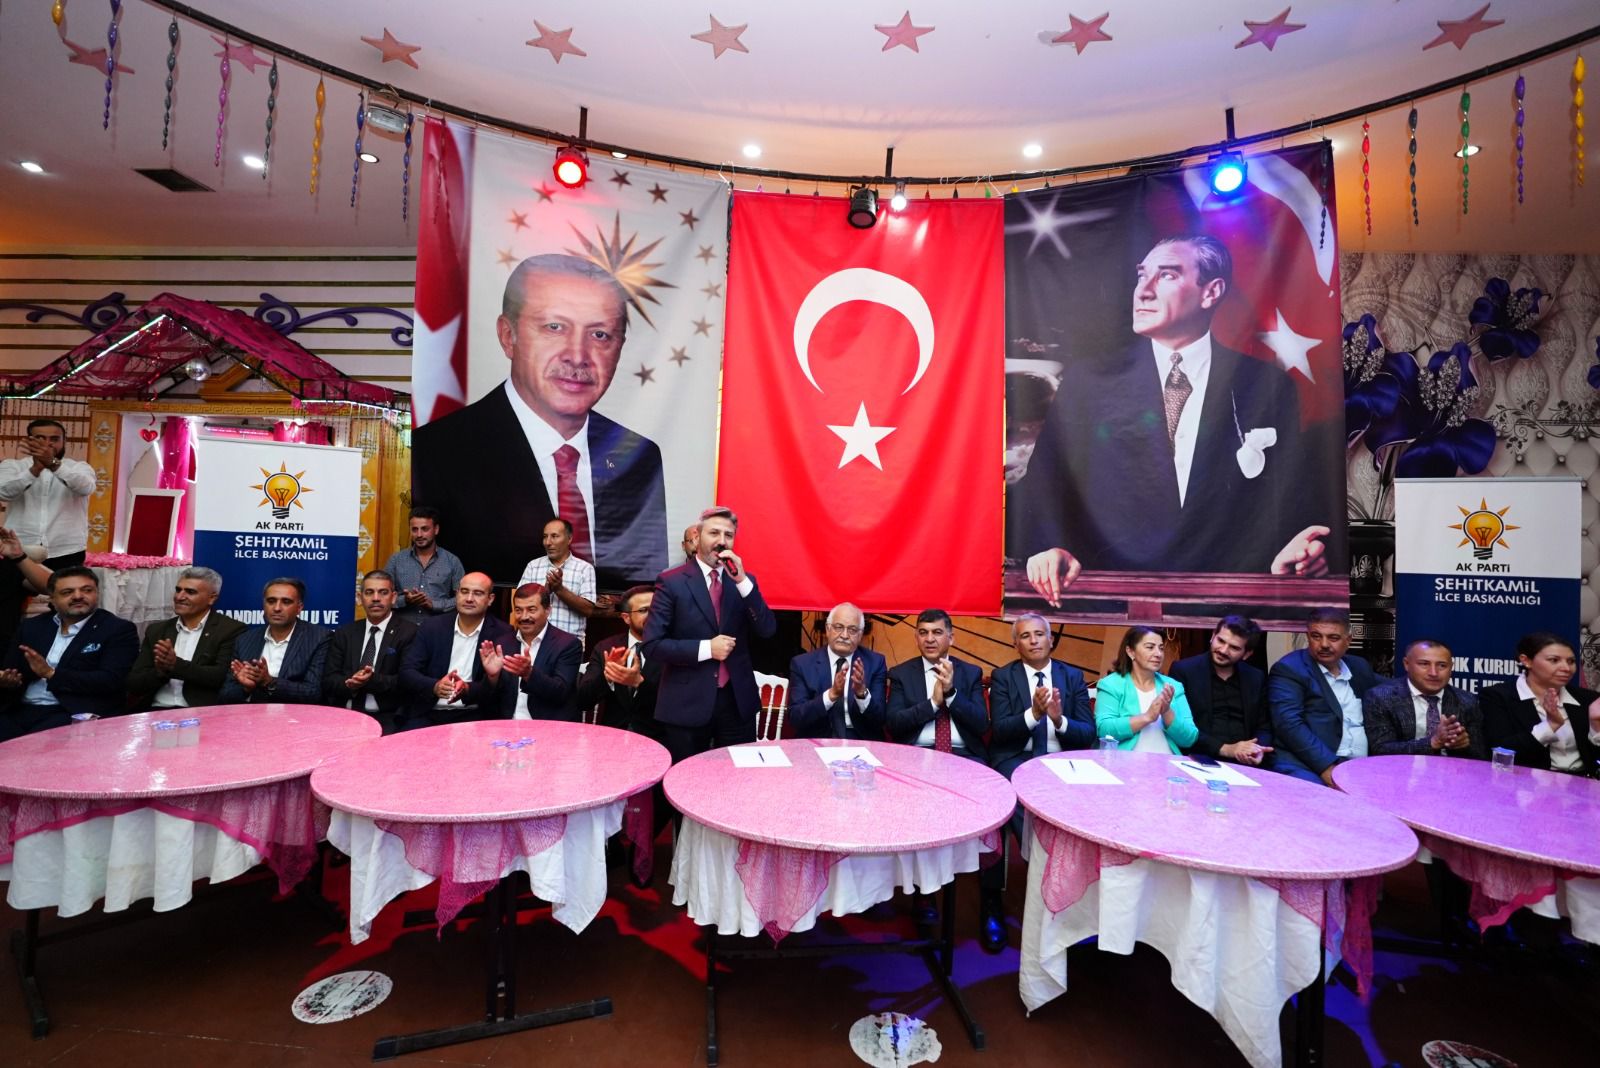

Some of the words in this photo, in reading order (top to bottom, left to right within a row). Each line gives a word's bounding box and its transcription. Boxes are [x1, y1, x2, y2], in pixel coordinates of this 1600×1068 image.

[255, 521, 271, 530] AK
[1455, 562, 1472, 572] AK
[323, 610, 340, 625] VE
[1473, 657, 1522, 676] KURUL
